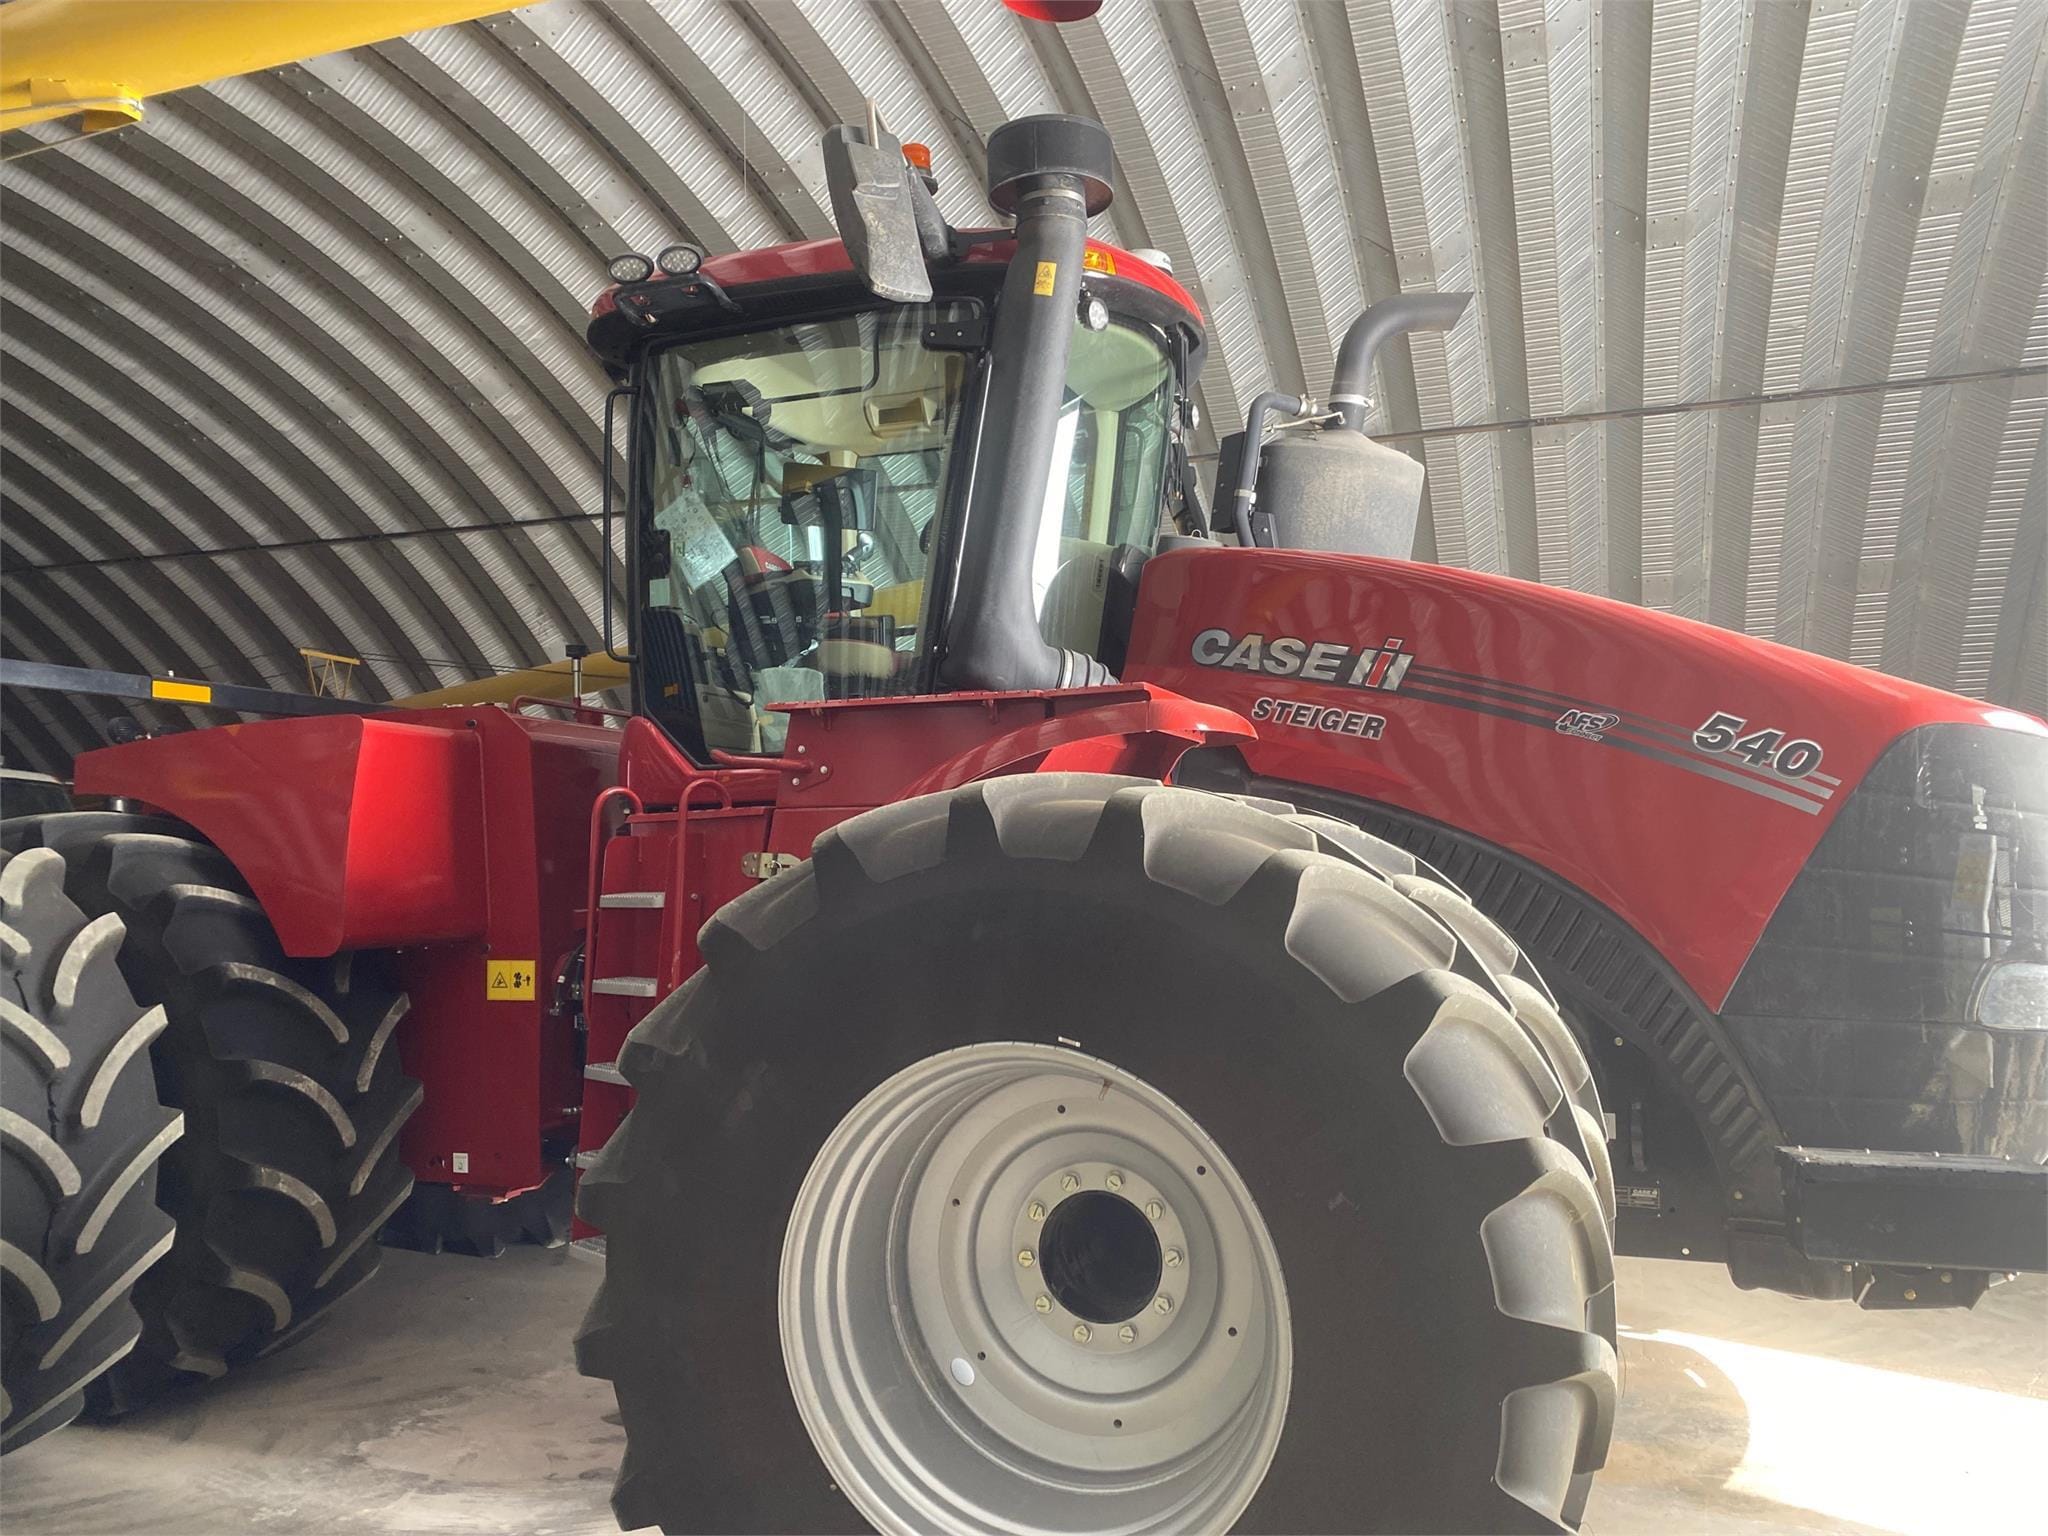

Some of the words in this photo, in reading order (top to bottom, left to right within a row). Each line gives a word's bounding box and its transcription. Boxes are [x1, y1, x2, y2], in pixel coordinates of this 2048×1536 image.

[1191, 629, 1350, 681] CASE
[1252, 697, 1387, 740] STEIGER
[1555, 709, 1607, 731] AFS
[1692, 711, 1824, 779] 540
